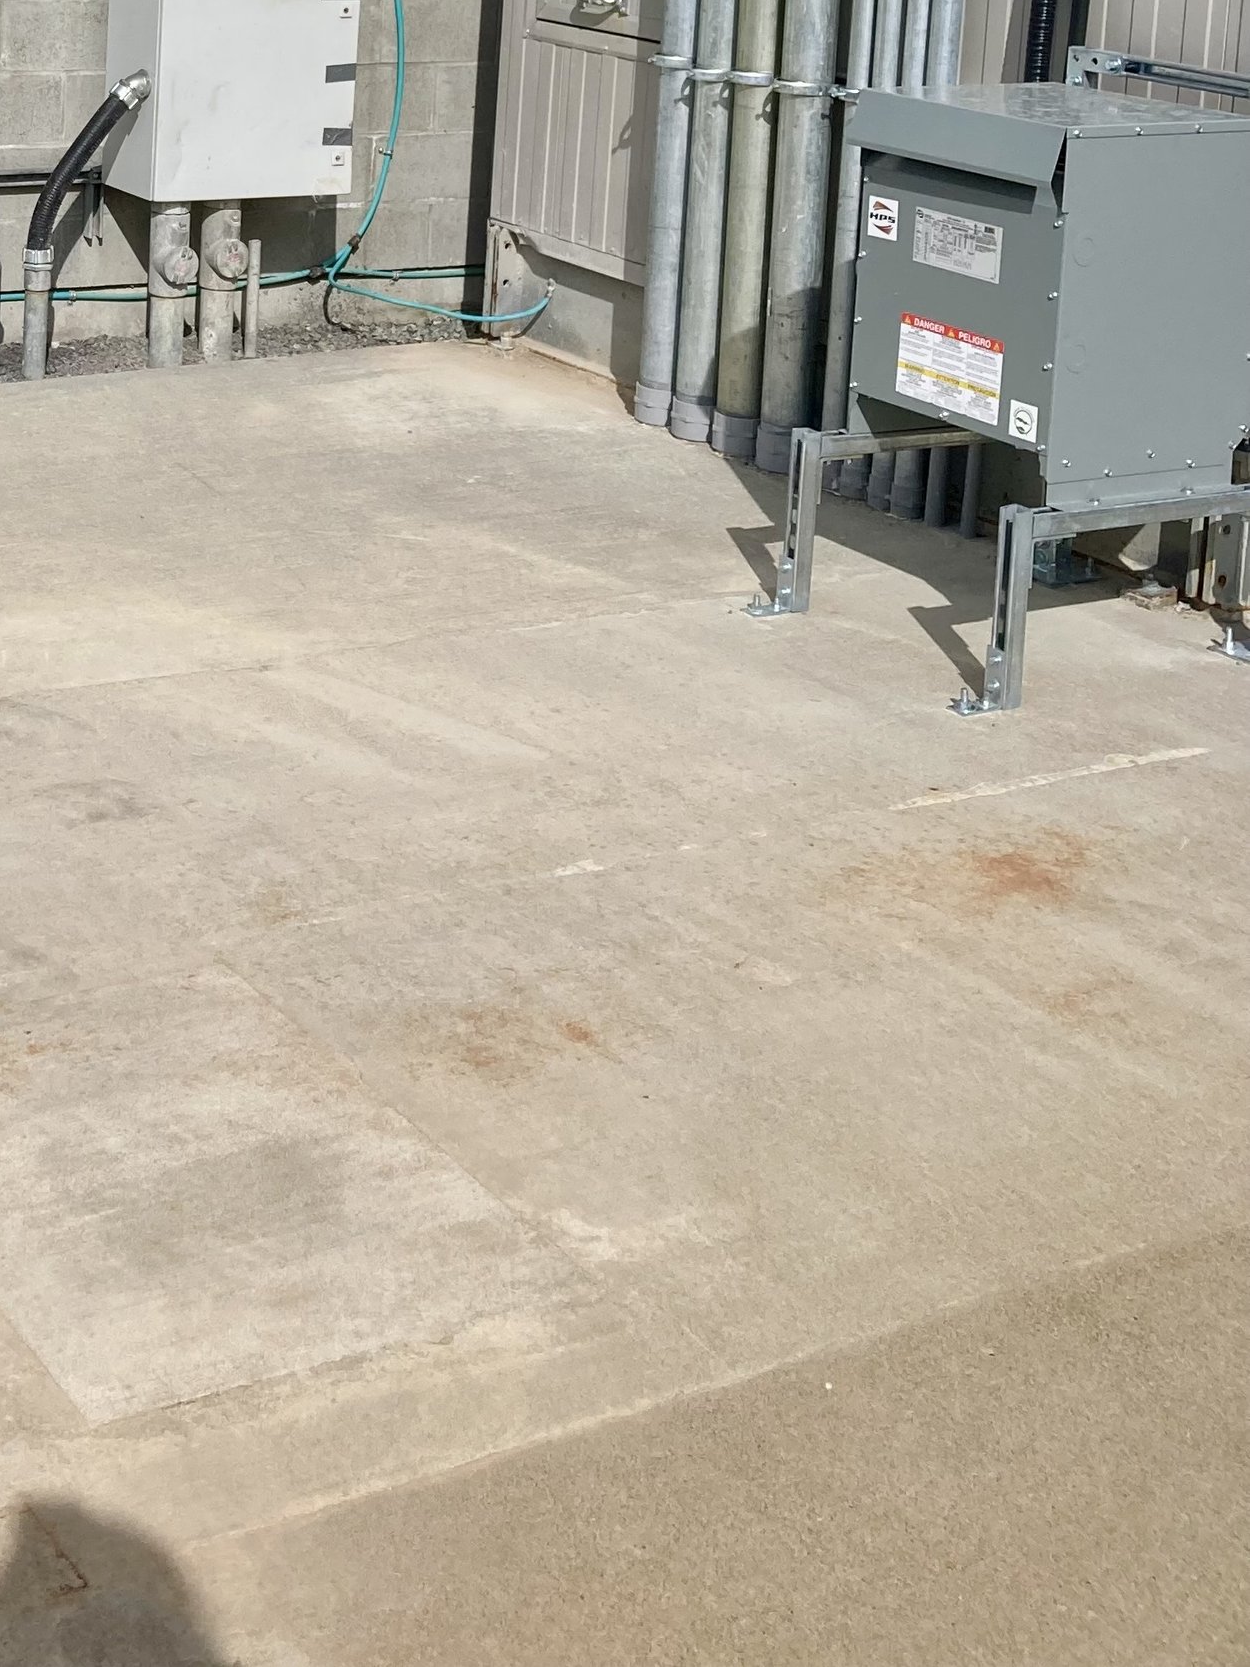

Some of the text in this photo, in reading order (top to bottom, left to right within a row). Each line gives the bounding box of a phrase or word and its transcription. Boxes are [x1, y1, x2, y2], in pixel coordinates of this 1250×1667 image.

[869, 212, 896, 224] HPS
[914, 318, 991, 349] DANGER PELIGRO
